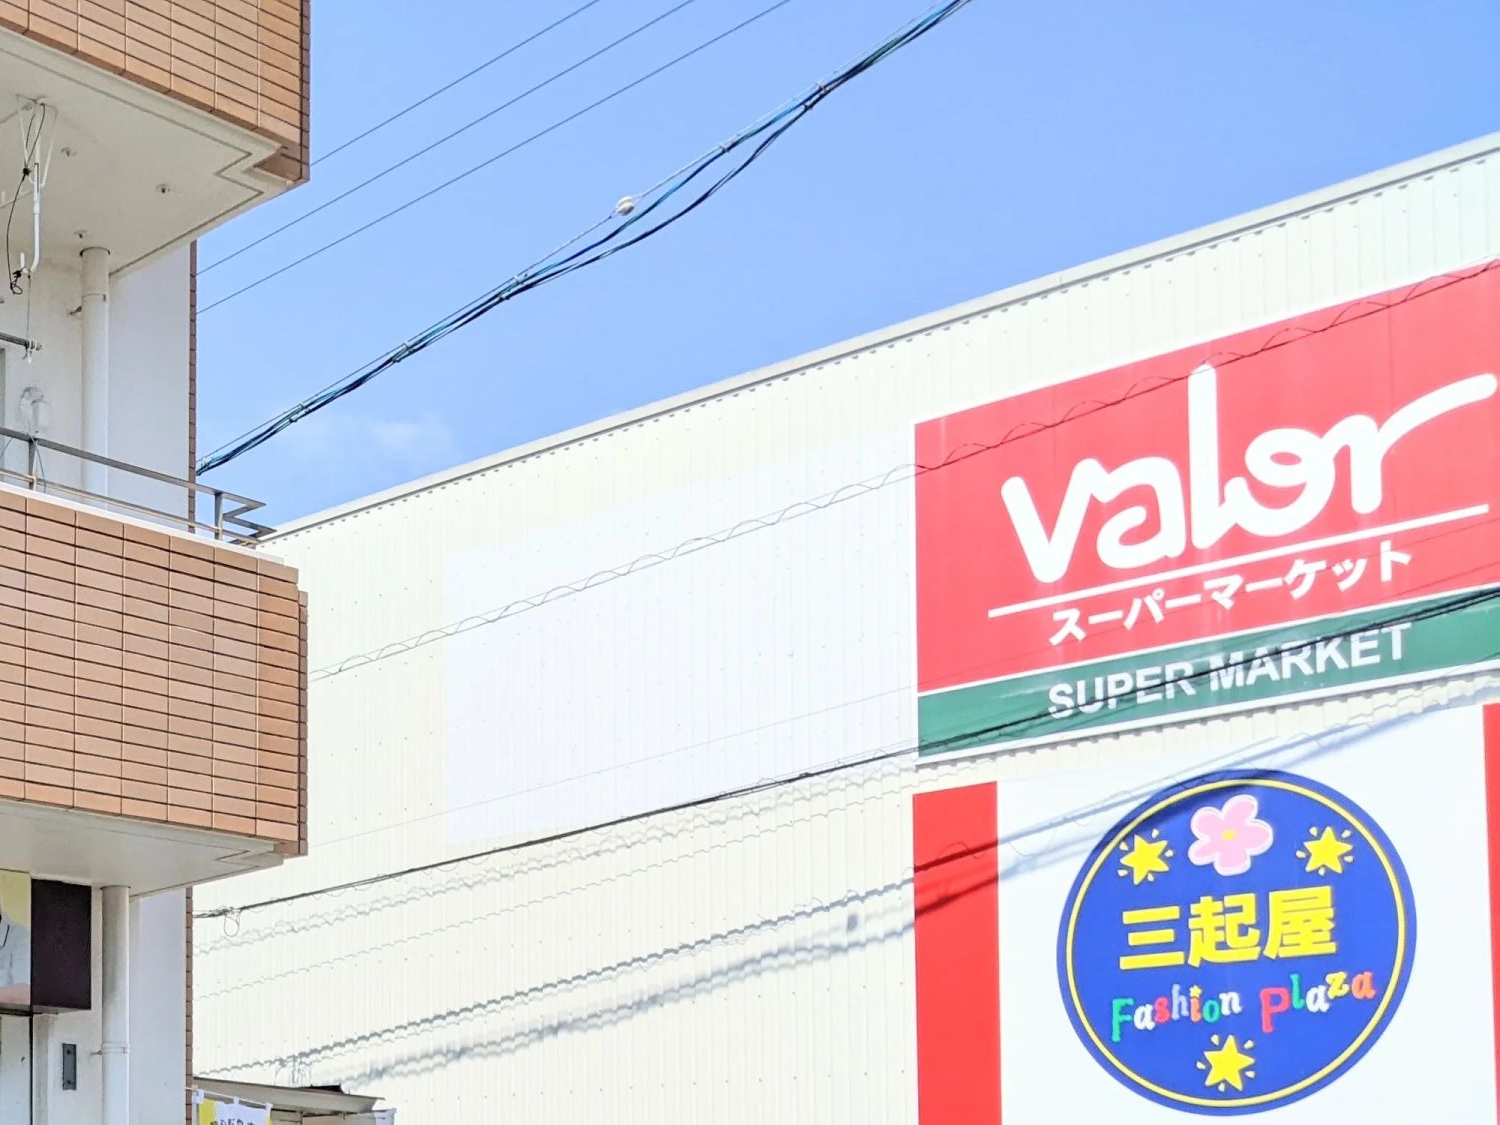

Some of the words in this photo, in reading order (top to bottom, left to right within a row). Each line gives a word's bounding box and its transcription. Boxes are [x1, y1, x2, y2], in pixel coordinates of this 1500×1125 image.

[1048, 540, 1412, 647] スーパーマーケット
[1047, 658, 1196, 719] SUPER
[1209, 621, 1413, 688] MARKET
[1118, 885, 1337, 971] 三起屋
[1110, 985, 1243, 1042] Fashion
